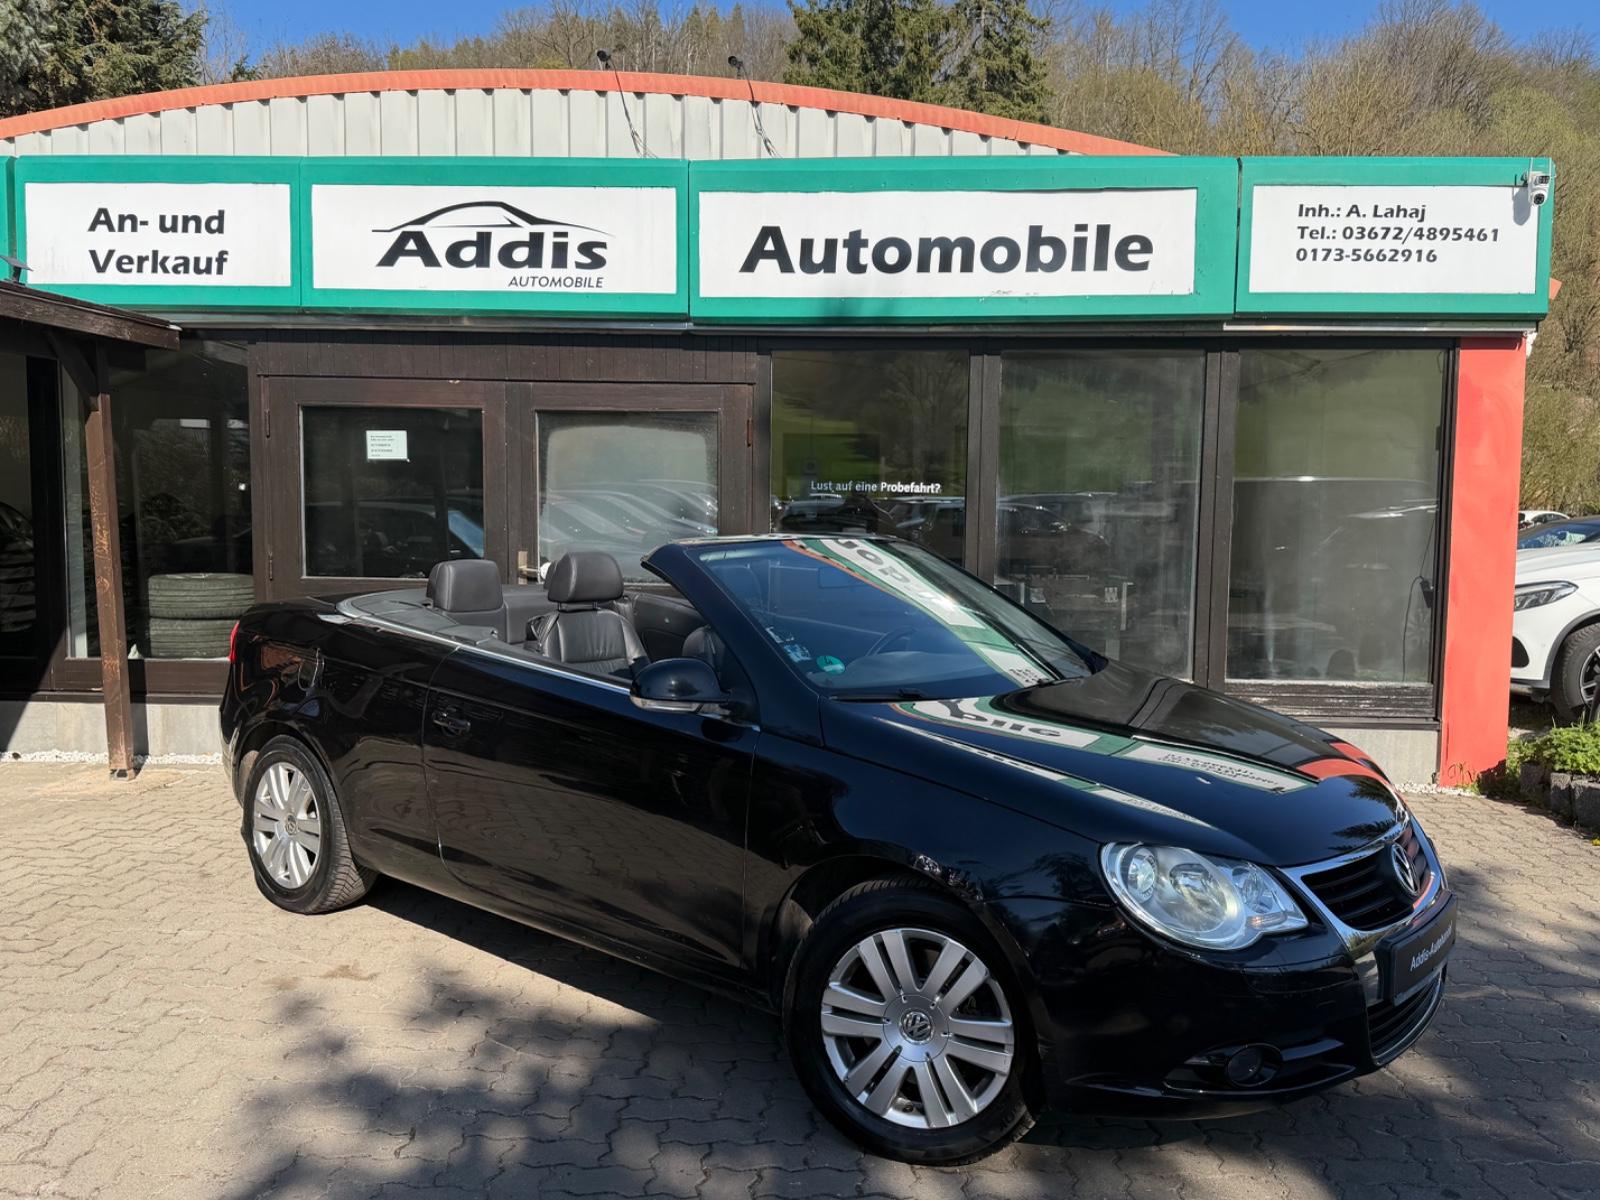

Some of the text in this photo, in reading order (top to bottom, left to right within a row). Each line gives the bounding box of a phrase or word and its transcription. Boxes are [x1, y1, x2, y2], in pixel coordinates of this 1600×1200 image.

[87, 207, 225, 235] An- und
[1298, 203, 1426, 223] Inh.: A. Lahaj
[1297, 226, 1499, 245] Tel.: 03672/4895461
[375, 230, 608, 270] Addis
[738, 223, 1154, 274] Automobile
[1296, 248, 1438, 263] 0173-5662916
[88, 249, 229, 275] Verkauf
[508, 276, 604, 289] AUTOMOBILE
[810, 480, 942, 494] Lust auf eine Probefahrt?
